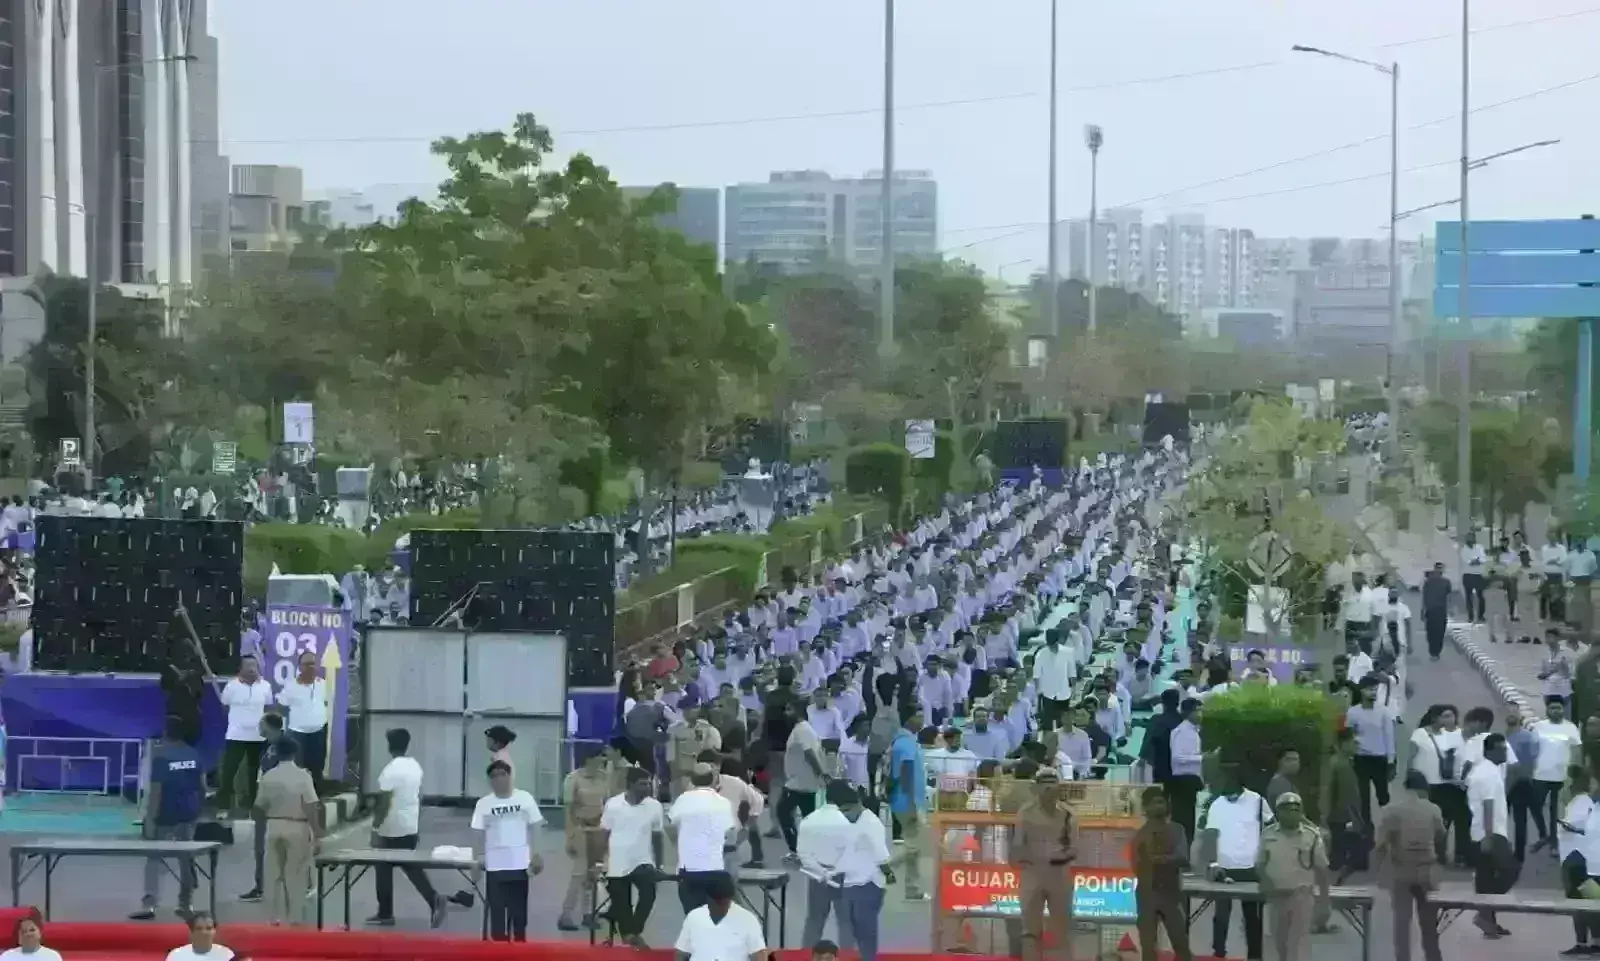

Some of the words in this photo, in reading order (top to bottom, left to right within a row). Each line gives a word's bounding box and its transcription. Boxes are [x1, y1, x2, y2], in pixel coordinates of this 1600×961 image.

[271, 610, 319, 627] BLOCK
[275, 631, 318, 658] 03
[951, 869, 1020, 889] GUJAR
